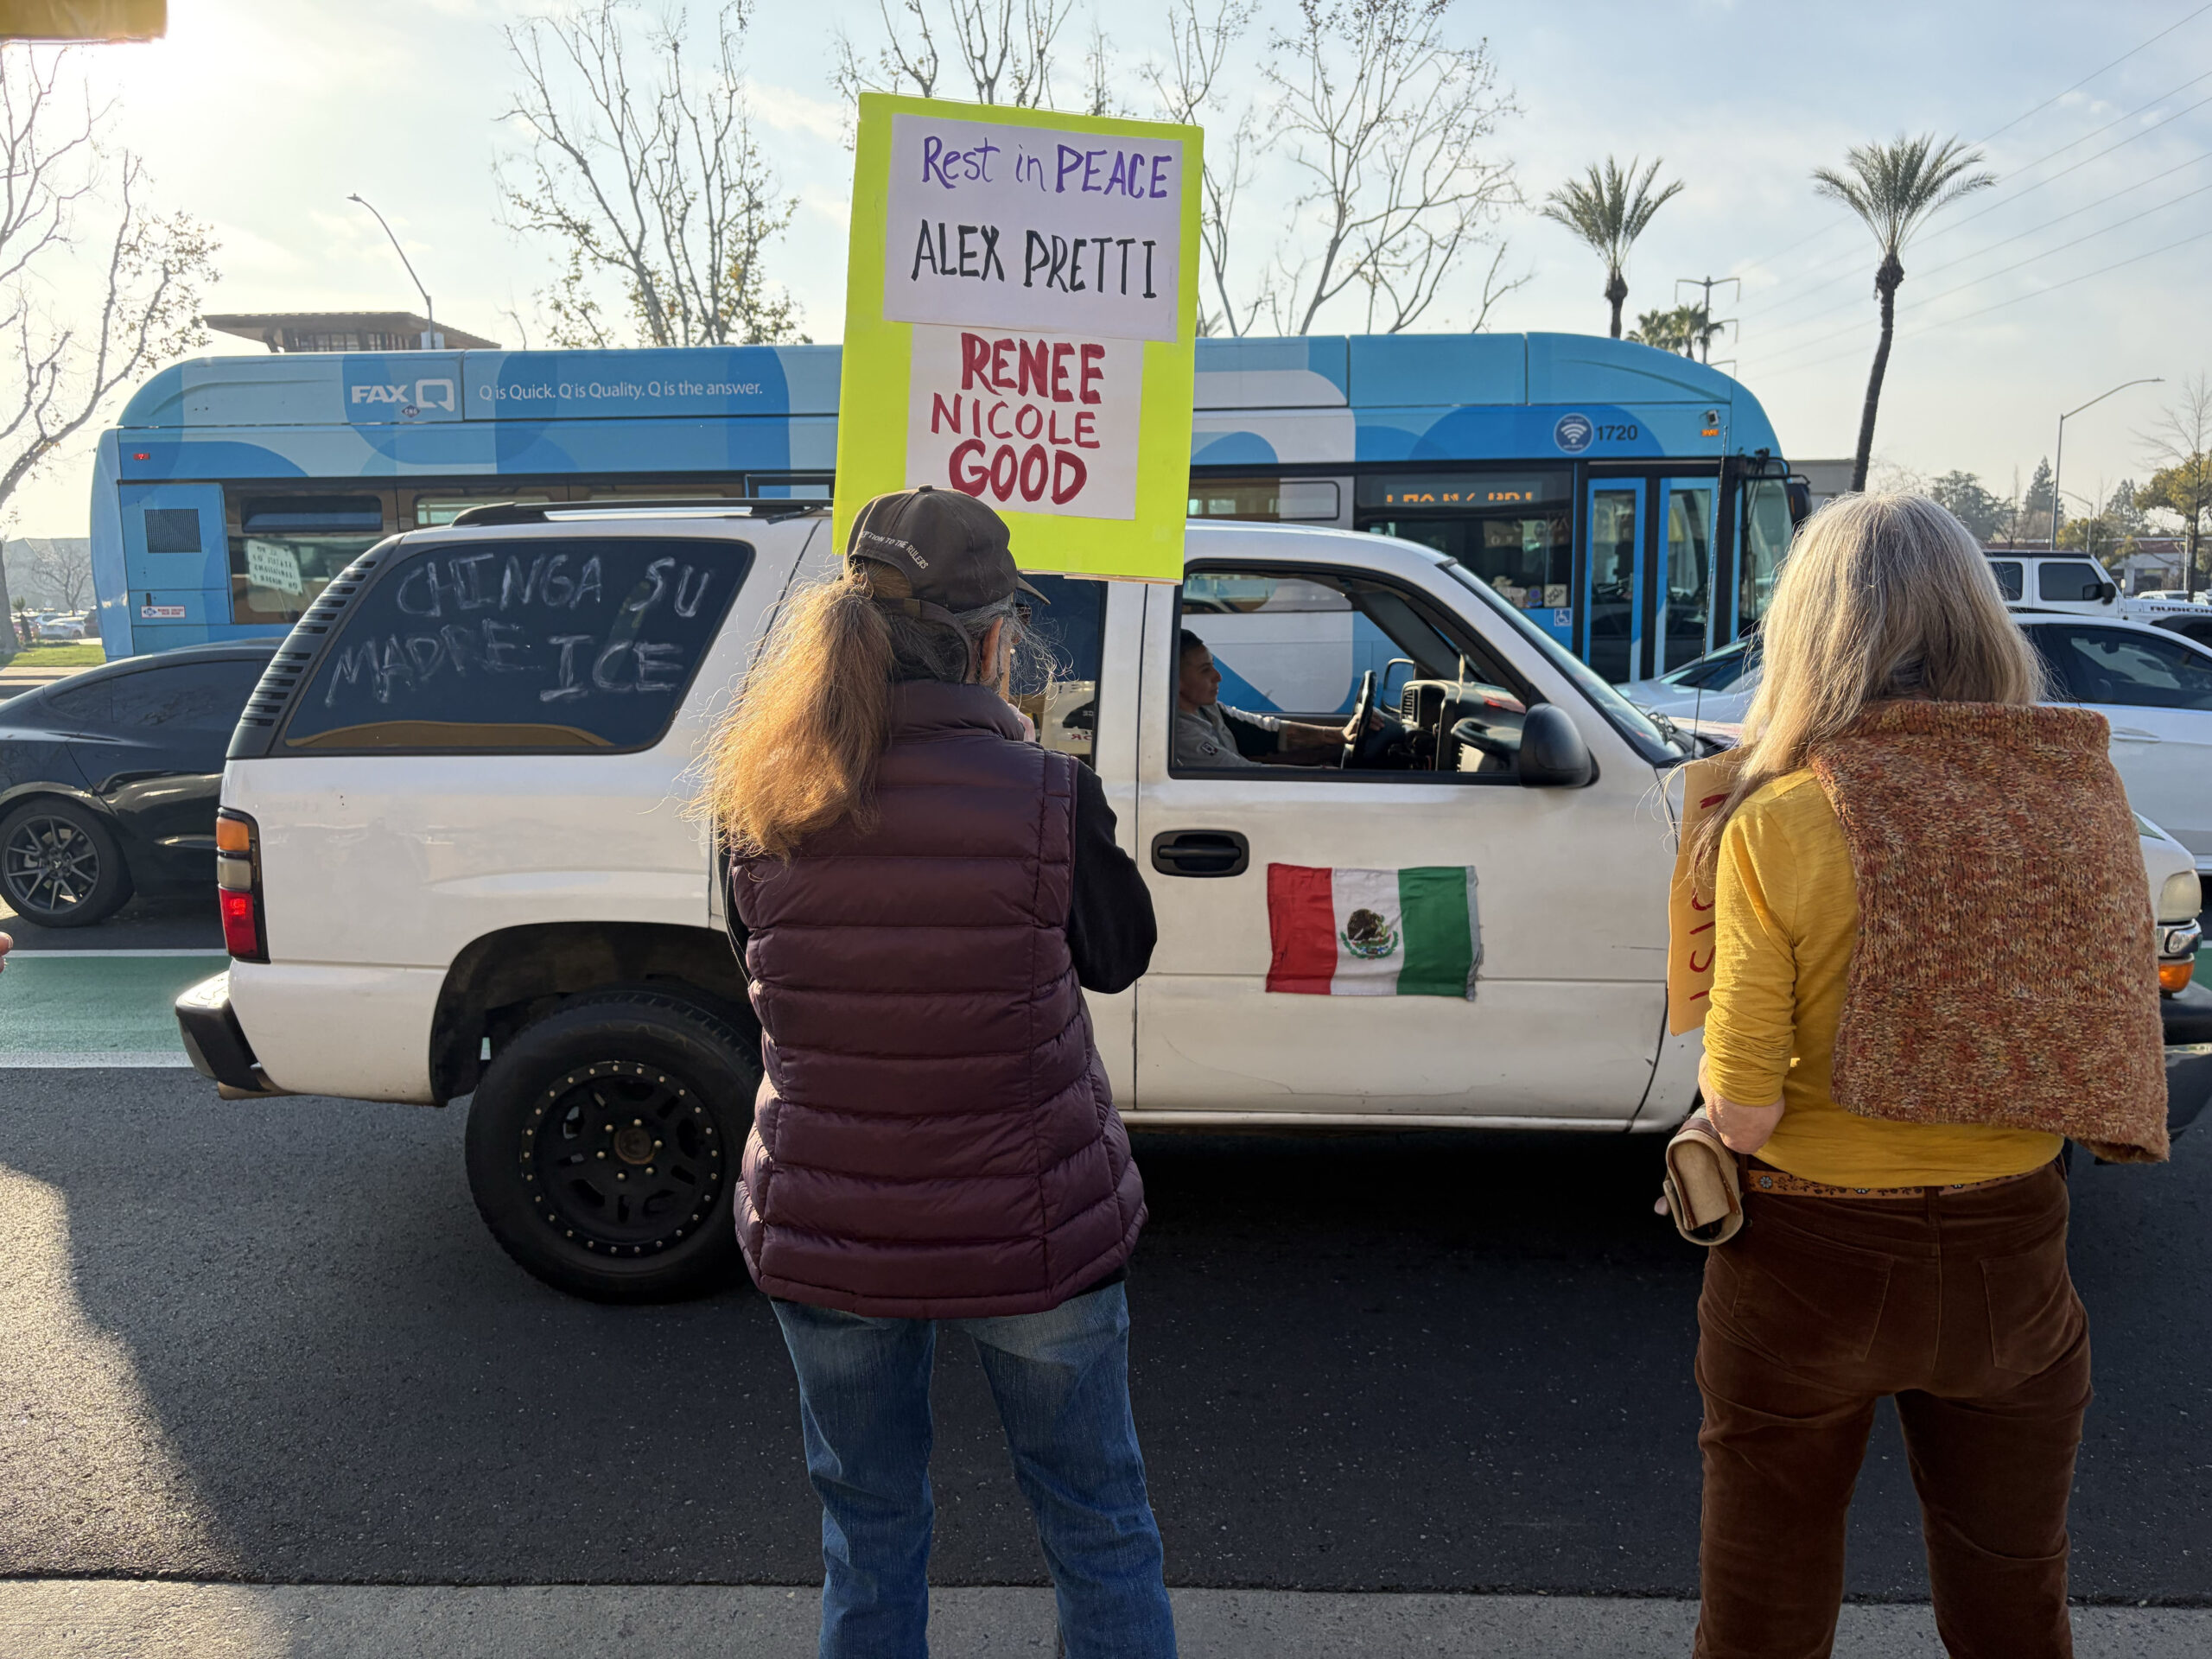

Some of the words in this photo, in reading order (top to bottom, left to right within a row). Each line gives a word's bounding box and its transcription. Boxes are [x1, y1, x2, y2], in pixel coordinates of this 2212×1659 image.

[922, 136, 1001, 189] Rest
[1015, 144, 1046, 192] in
[1055, 143, 1173, 199] PEACE
[911, 219, 1005, 282] ALEX
[1023, 230, 1157, 298] PRETTI
[351, 385, 409, 404] FAX
[479, 385, 493, 401] Q
[496, 385, 506, 399] is
[509, 383, 556, 400] Quick.
[559, 383, 572, 399] Q
[575, 383, 586, 397] is
[589, 381, 645, 400] Quality.
[648, 381, 661, 397] Q
[664, 381, 676, 396] is
[678, 380, 703, 395] the
[707, 382, 763, 395] answer.
[961, 332, 1105, 404] RENEE
[931, 392, 1101, 448] NICOLE
[1597, 424, 1638, 441] 1720
[949, 438, 1087, 505] GOOD
[885, 537, 894, 545] TO
[894, 539, 909, 549] THE
[906, 545, 929, 569] RULERS
[397, 554, 602, 617] CHINGA
[629, 556, 711, 618] SU
[540, 635, 684, 702] ICE
